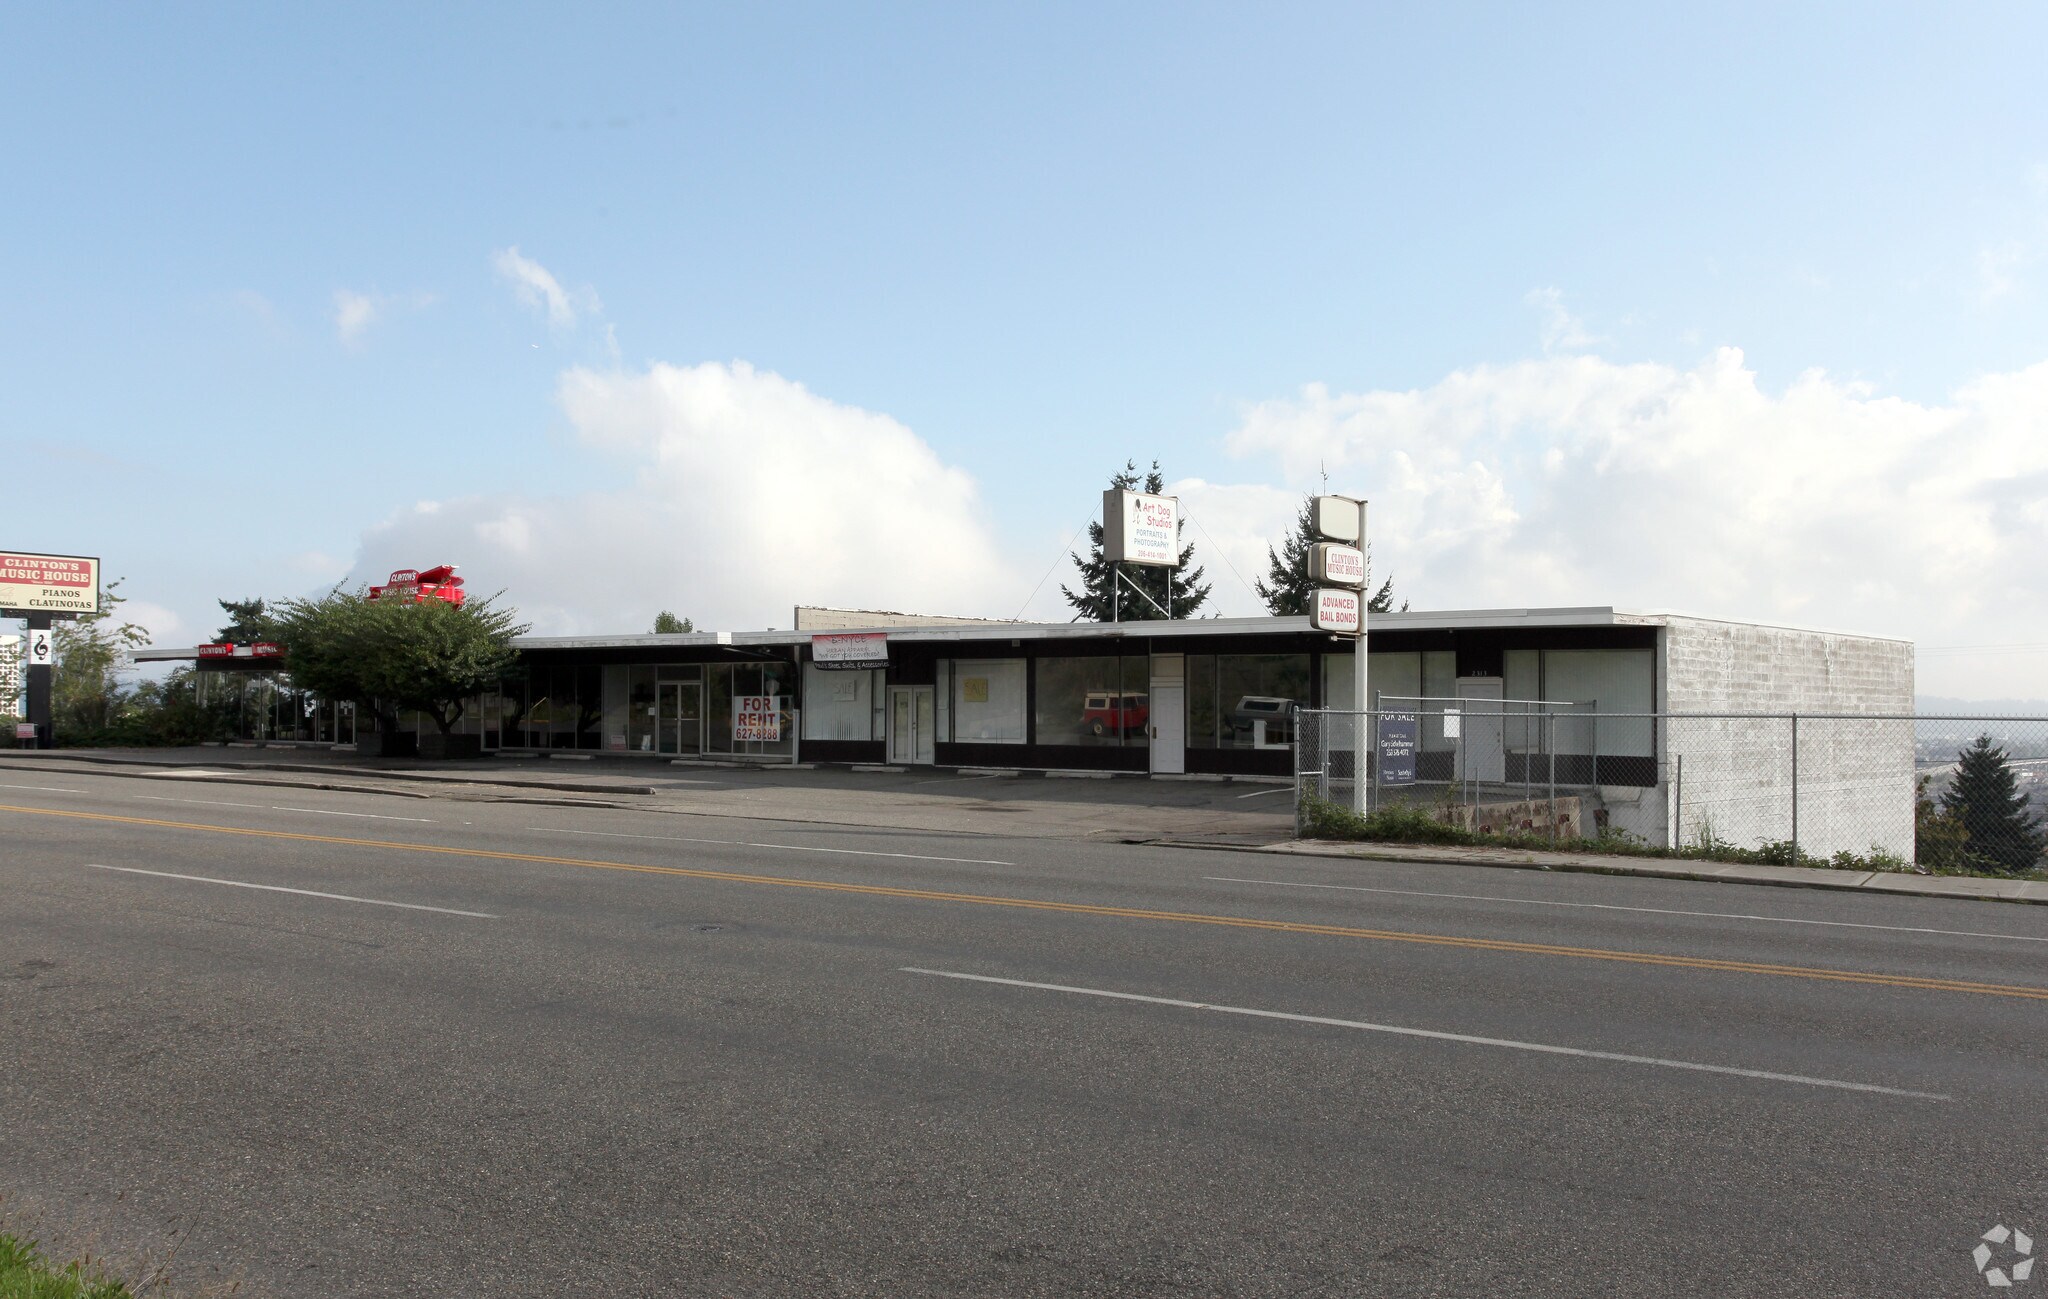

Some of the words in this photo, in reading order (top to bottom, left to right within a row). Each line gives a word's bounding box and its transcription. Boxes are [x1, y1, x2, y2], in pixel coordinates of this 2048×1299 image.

[1143, 502, 1155, 513] Art
[1157, 504, 1171, 519] Dog
[1146, 515, 1172, 529] Studios
[1136, 528, 1163, 539] PORTRAITS
[1133, 537, 1169, 549] PHOTOGRAPHY
[4, 558, 79, 571] CLINTON'S
[1331, 552, 1359, 566] CLINTON'S
[43, 570, 89, 583] HOUSE
[1327, 562, 1344, 575] MUSIC
[1345, 564, 1363, 577] HOUSE
[42, 589, 81, 598] PIANOS
[29, 598, 92, 609] CLAVINOVAS
[1322, 596, 1355, 610] ADVANCED
[1320, 610, 1335, 622] BAIL
[1336, 611, 1357, 624] BONDS
[743, 697, 772, 711] FOR
[738, 712, 776, 727] RENT
